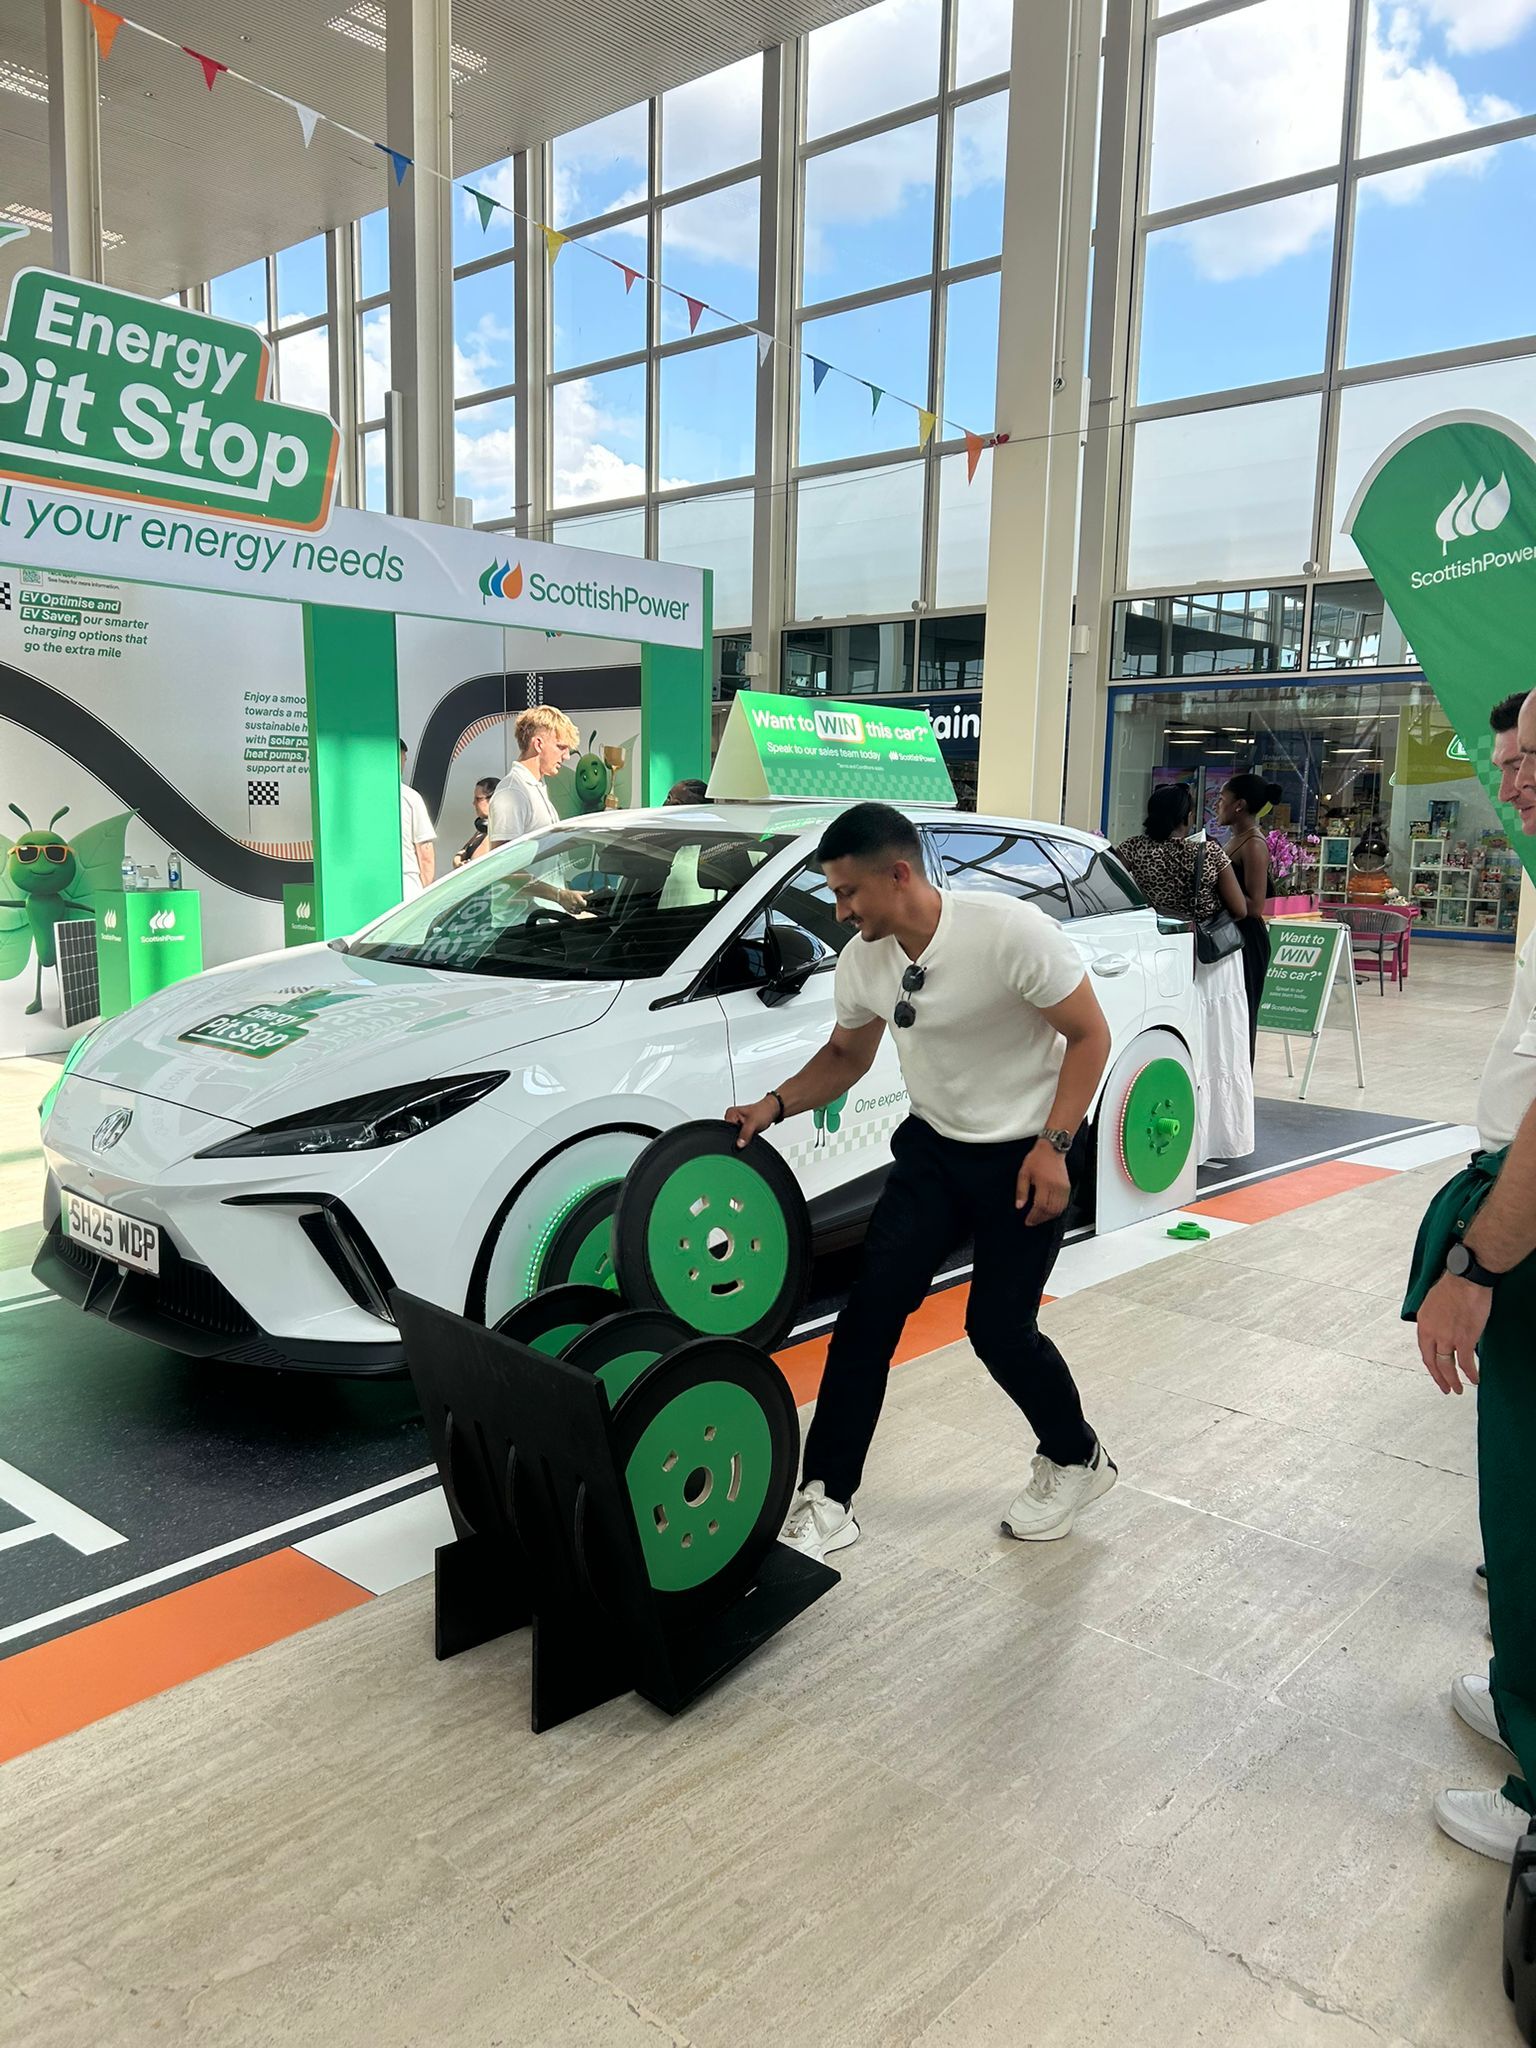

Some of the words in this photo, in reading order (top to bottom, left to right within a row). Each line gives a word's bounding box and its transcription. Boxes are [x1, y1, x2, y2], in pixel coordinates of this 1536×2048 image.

[35, 288, 247, 395] Energy
[0, 351, 95, 446] Pit
[112, 382, 309, 501] Stop
[24, 499, 132, 542] your
[140, 518, 287, 573] energy
[292, 541, 404, 582] needs
[21, 591, 40, 602] EV
[41, 594, 95, 610] Optimise
[97, 600, 119, 612] and
[529, 573, 689, 621] ScottishPower
[22, 608, 41, 619] EV
[42, 609, 79, 625] Saver,
[83, 615, 103, 625] our
[104, 617, 149, 630] smarter
[23, 625, 77, 641] charging
[79, 629, 122, 644] options
[125, 633, 148, 645] that
[24, 642, 40, 653] go
[43, 641, 62, 653] the
[65, 645, 95, 656] extra
[98, 647, 121, 658] mile
[243, 691, 271, 704] Enjoy
[245, 706, 284, 717] towards
[286, 710, 292, 718] a
[245, 721, 300, 732] sustainable
[751, 709, 796, 730] Want
[797, 714, 815, 732] to
[818, 715, 857, 736] WIN
[865, 721, 893, 739] this
[246, 734, 267, 744] with
[270, 736, 295, 746] solar
[246, 749, 268, 759] heat
[269, 752, 304, 761] pumps,
[767, 741, 794, 755] Speak
[794, 744, 803, 754] to
[804, 747, 817, 755] our
[819, 747, 839, 757] sales
[840, 749, 859, 758] team
[860, 749, 881, 761] today
[246, 764, 284, 774] support
[286, 765, 296, 773] at
[1279, 931, 1312, 944] Want
[1313, 934, 1325, 945] to
[1280, 948, 1315, 963] WIN
[1266, 967, 1288, 979] this
[243, 1006, 305, 1026] Energy
[196, 1017, 243, 1036] Pit
[228, 1022, 289, 1048] Stop
[855, 1098, 876, 1113] One
[70, 1198, 114, 1247] SH25
[119, 1217, 155, 1261] WDP
